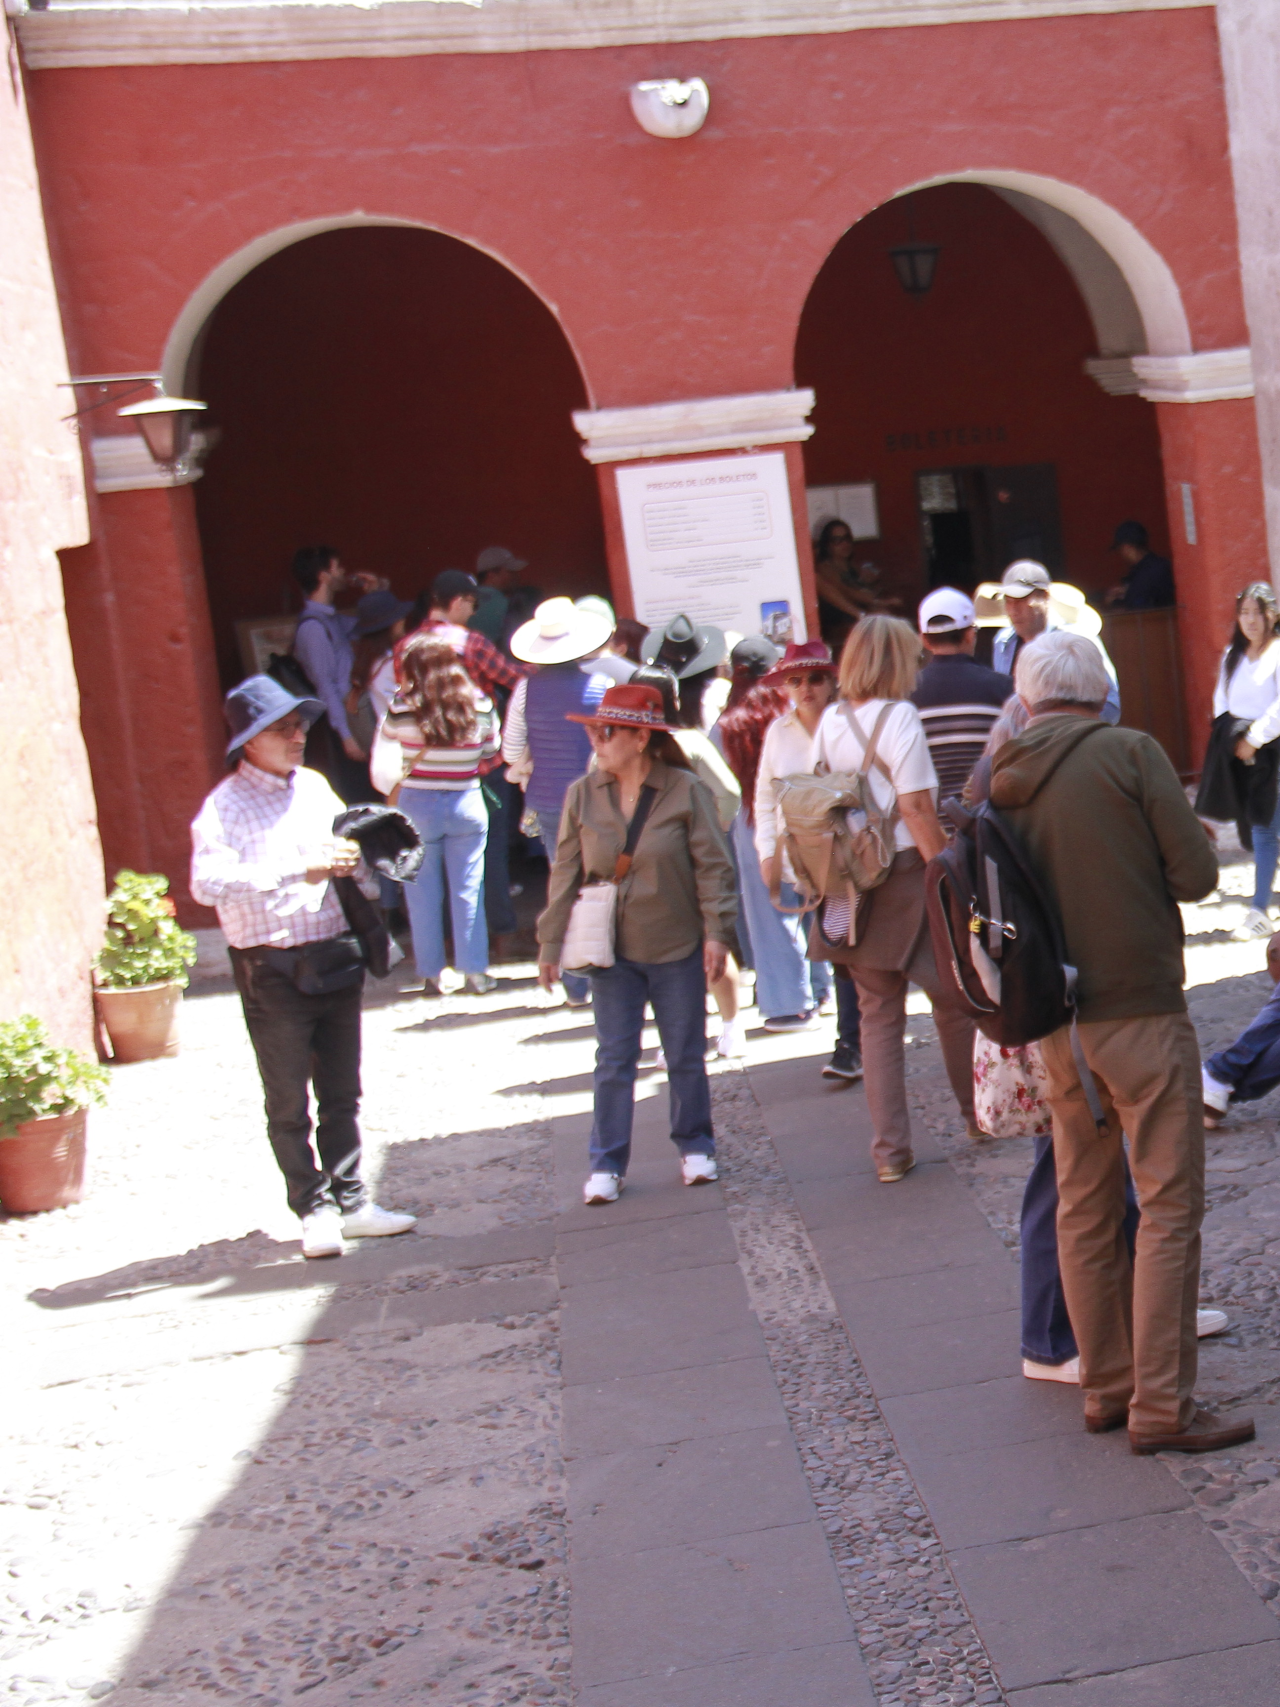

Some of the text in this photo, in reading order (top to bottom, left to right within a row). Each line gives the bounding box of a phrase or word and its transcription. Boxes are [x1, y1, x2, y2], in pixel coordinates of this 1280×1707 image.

[646, 472, 758, 491] PRECIOS DE LOS BOLETOS
